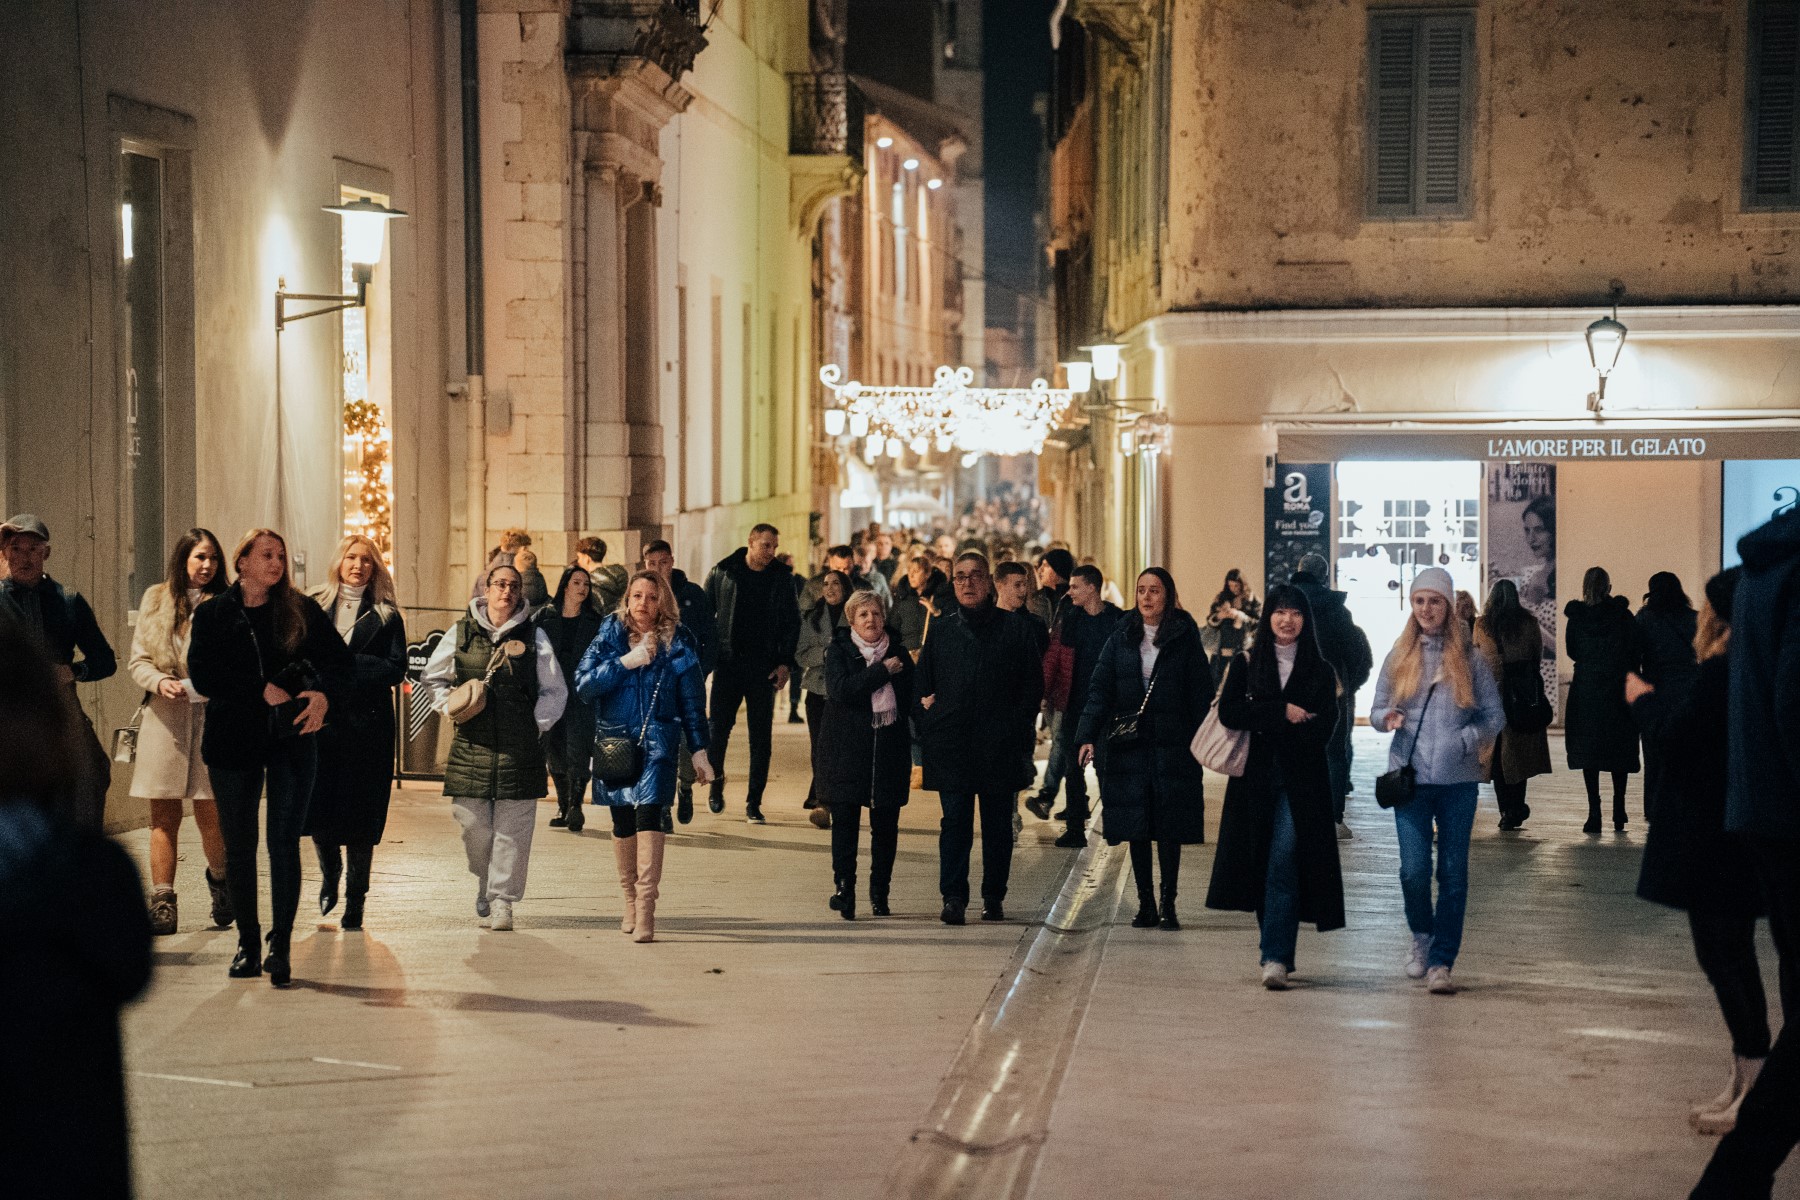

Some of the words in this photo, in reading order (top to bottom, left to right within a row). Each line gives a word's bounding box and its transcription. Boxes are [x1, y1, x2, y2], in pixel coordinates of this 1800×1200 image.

[1488, 439, 1568, 457] L'AMORE
[1571, 439, 1606, 456] PER
[1610, 438, 1628, 456] IL
[1631, 438, 1706, 456] GELATO
[1284, 472, 1312, 503] a
[1275, 520, 1296, 530] Find
[409, 656, 427, 665] BOB
